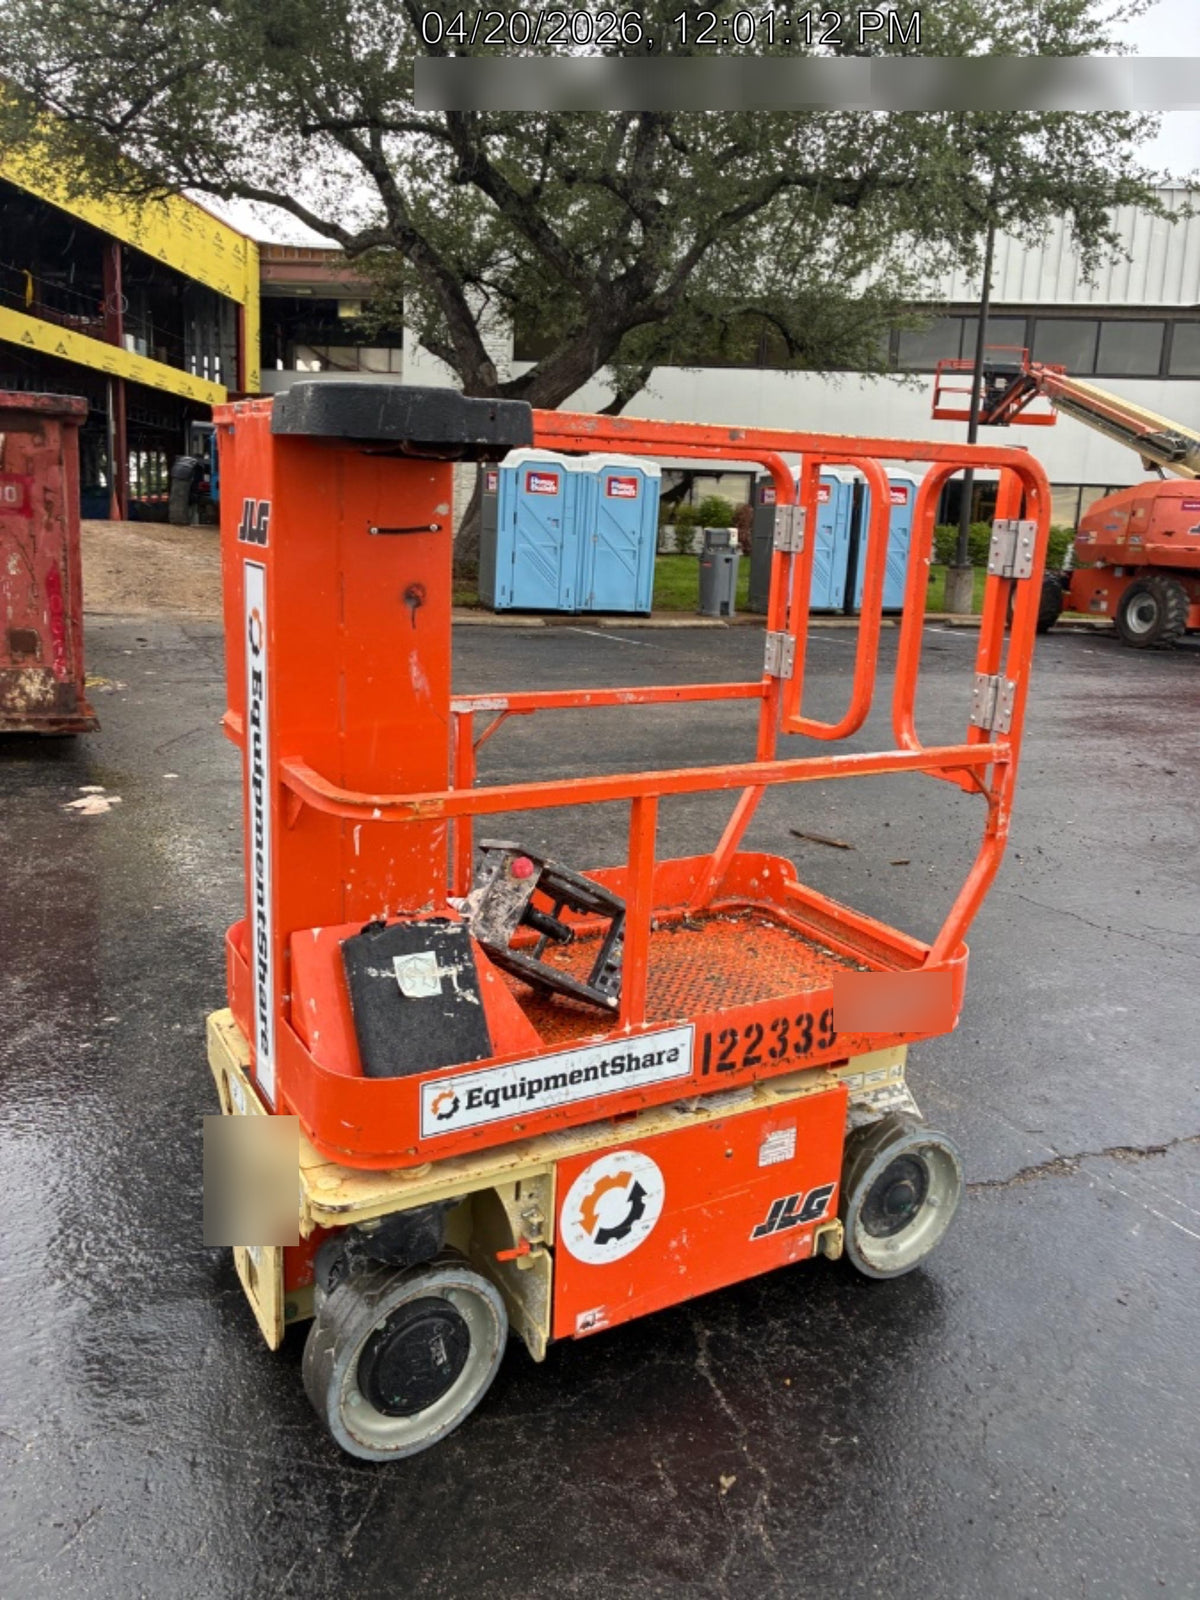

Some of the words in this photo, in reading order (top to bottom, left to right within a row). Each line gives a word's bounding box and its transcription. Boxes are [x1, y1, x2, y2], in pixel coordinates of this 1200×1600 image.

[238, 498, 271, 548] JLG
[249, 666, 269, 1056] EquipmentShare
[749, 1182, 838, 1241] JLG
